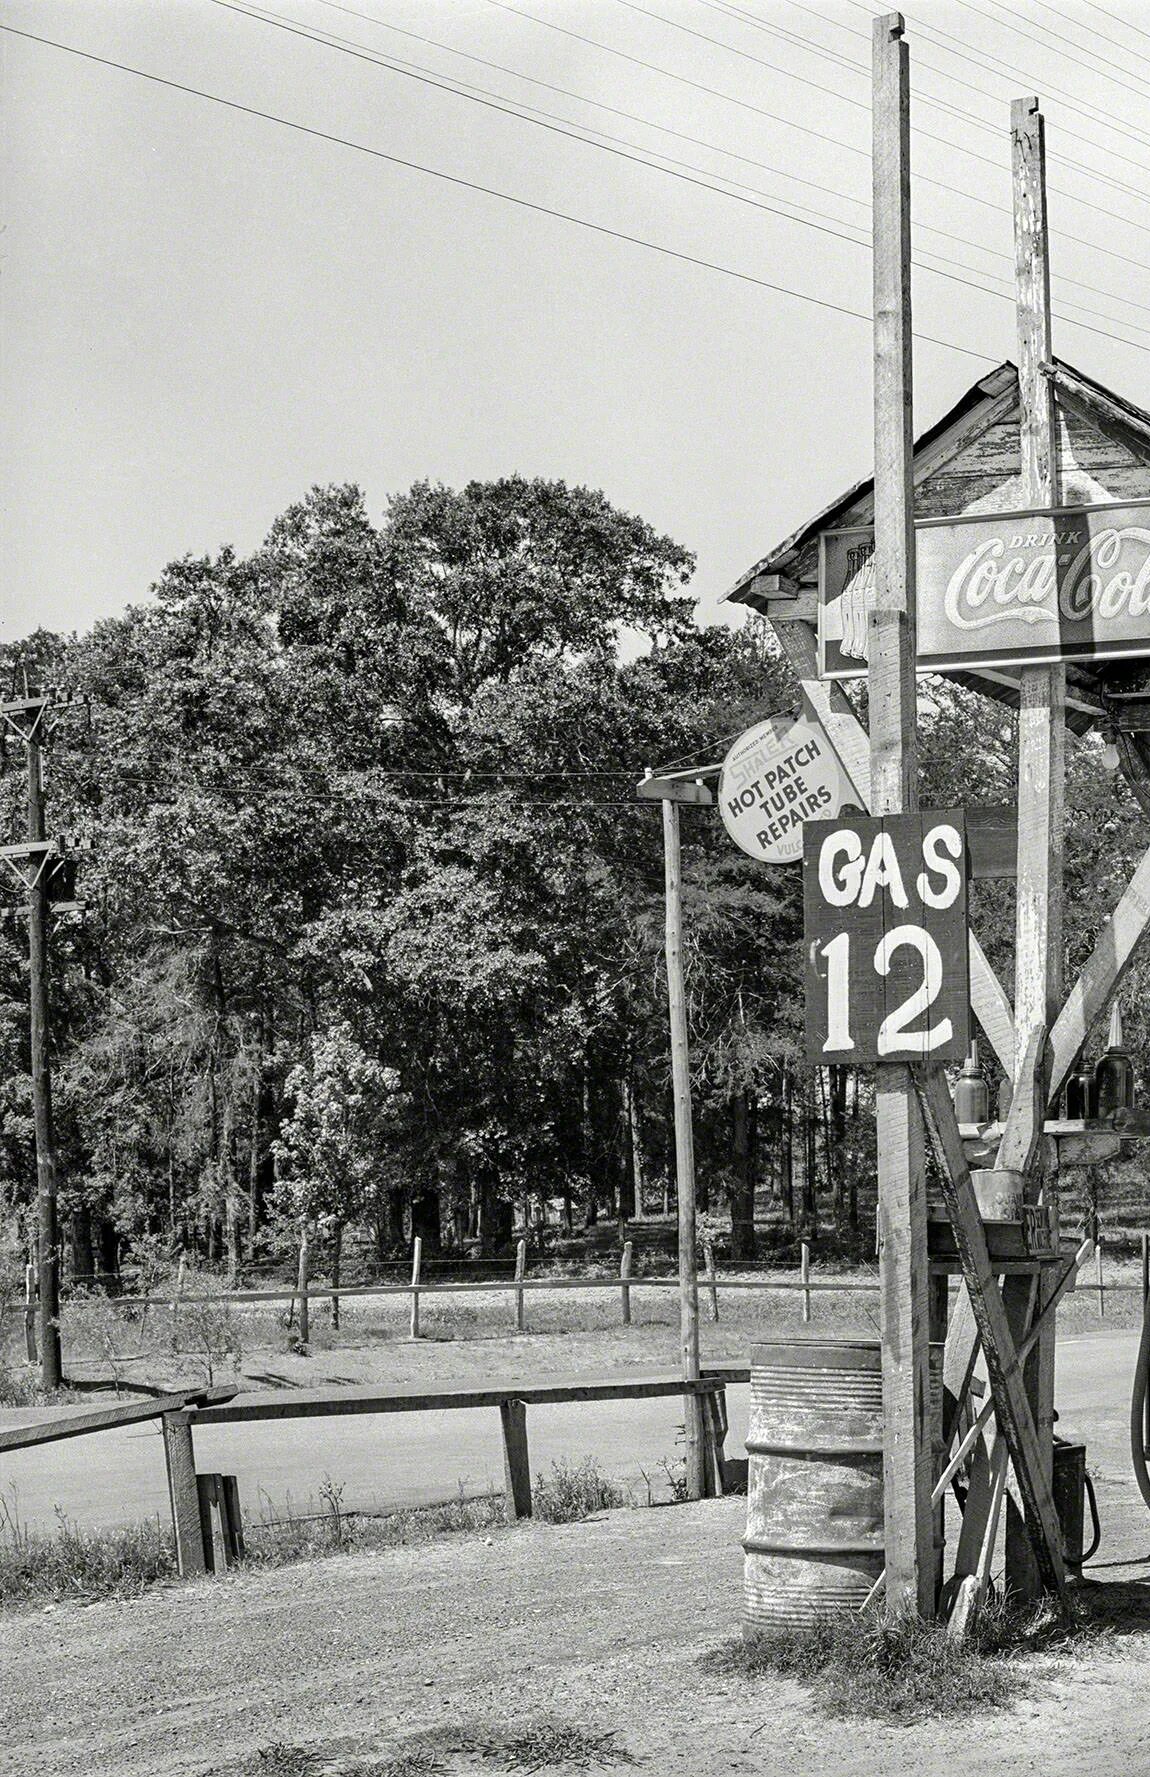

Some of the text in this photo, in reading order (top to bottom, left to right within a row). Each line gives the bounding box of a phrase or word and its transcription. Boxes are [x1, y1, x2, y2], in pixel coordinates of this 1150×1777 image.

[1008, 531, 1082, 550] DRINK
[727, 740, 821, 818] HOT PATCH
[759, 776, 808, 819] TUBE
[756, 785, 832, 849] REPAIRS
[818, 824, 962, 909] GAS
[821, 924, 953, 1056] 12
